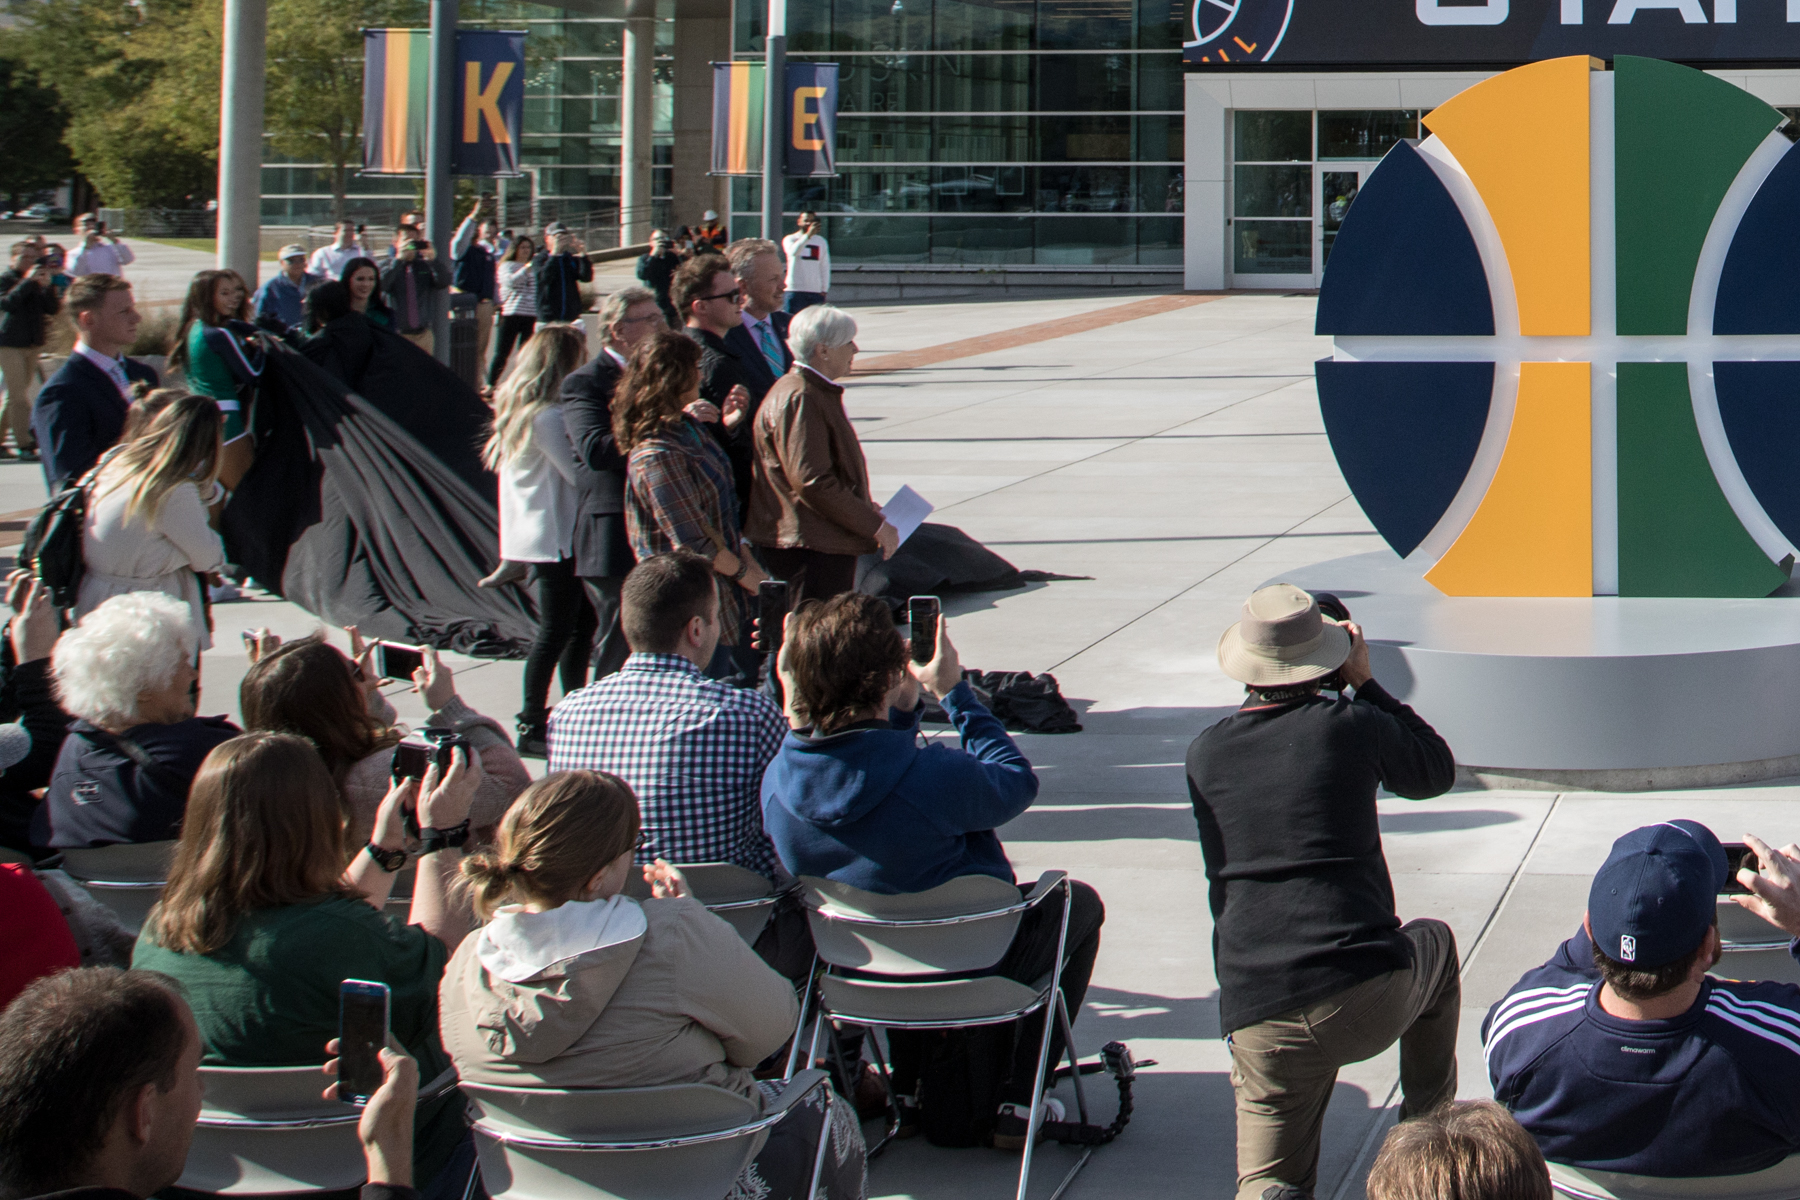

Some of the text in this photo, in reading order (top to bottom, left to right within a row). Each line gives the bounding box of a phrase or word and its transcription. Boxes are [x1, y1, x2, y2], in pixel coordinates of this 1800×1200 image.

[462, 61, 517, 144] K
[792, 86, 828, 151] E
[1620, 1045, 1656, 1055] climawarm
